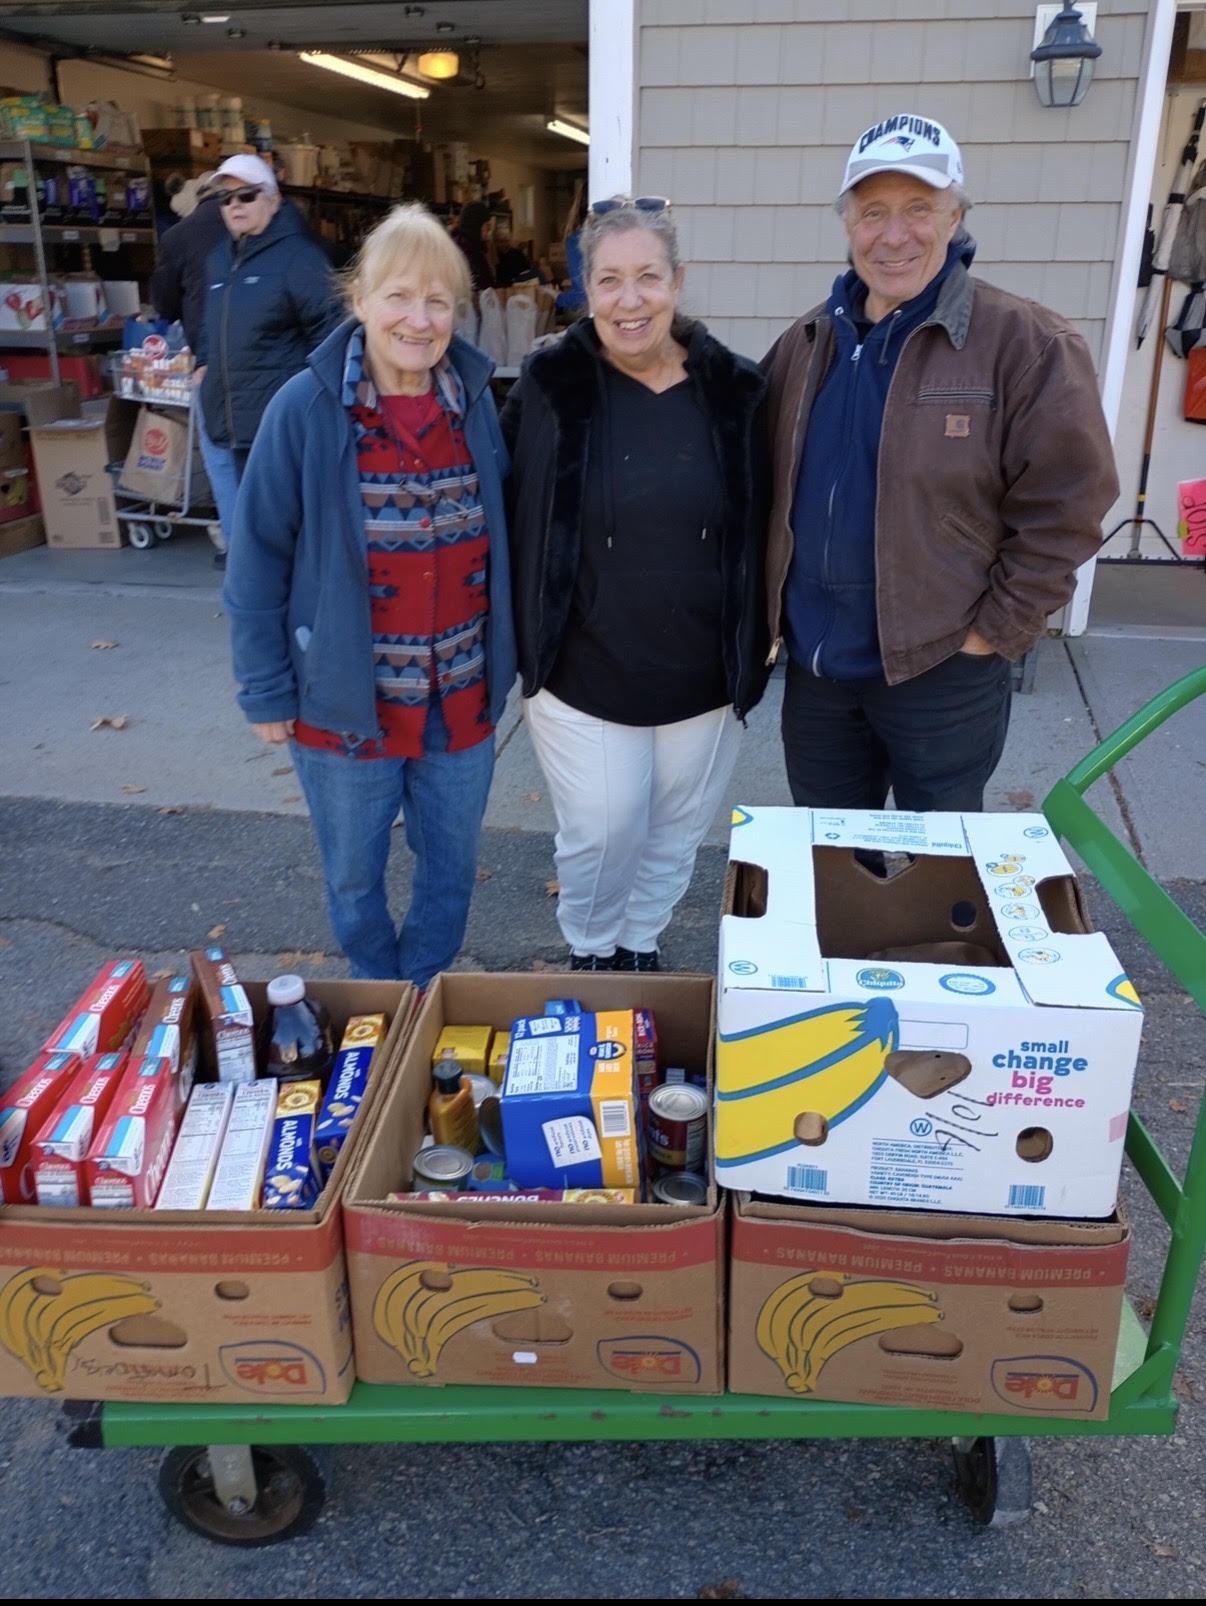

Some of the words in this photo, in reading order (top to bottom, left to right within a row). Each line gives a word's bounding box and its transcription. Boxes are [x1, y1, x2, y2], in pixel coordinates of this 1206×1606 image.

[859, 116, 941, 154] CHAMPIONS
[1182, 496, 1206, 547] STOP
[1020, 1040, 1069, 1054] small
[992, 1050, 1088, 1077] change
[334, 1051, 361, 1101] ALMONDS
[1011, 1070, 1054, 1095] big
[986, 1091, 1085, 1109] difference
[276, 1119, 299, 1172] ALMONDS
[219, 1251, 290, 1266] PREMIUM
[449, 1244, 515, 1260] PREMIUM
[535, 1249, 604, 1263] BANANAS
[607, 1250, 677, 1265] PREMIUM
[776, 1246, 848, 1266] BANANAS
[852, 1254, 922, 1274] PREMIUM
[944, 1263, 1018, 1280] BANANAS
[1022, 1263, 1092, 1281] PREMIUM
[236, 1362, 307, 1386] Dole
[611, 1356, 682, 1376] Dole
[1005, 1378, 1079, 1400] Dole
